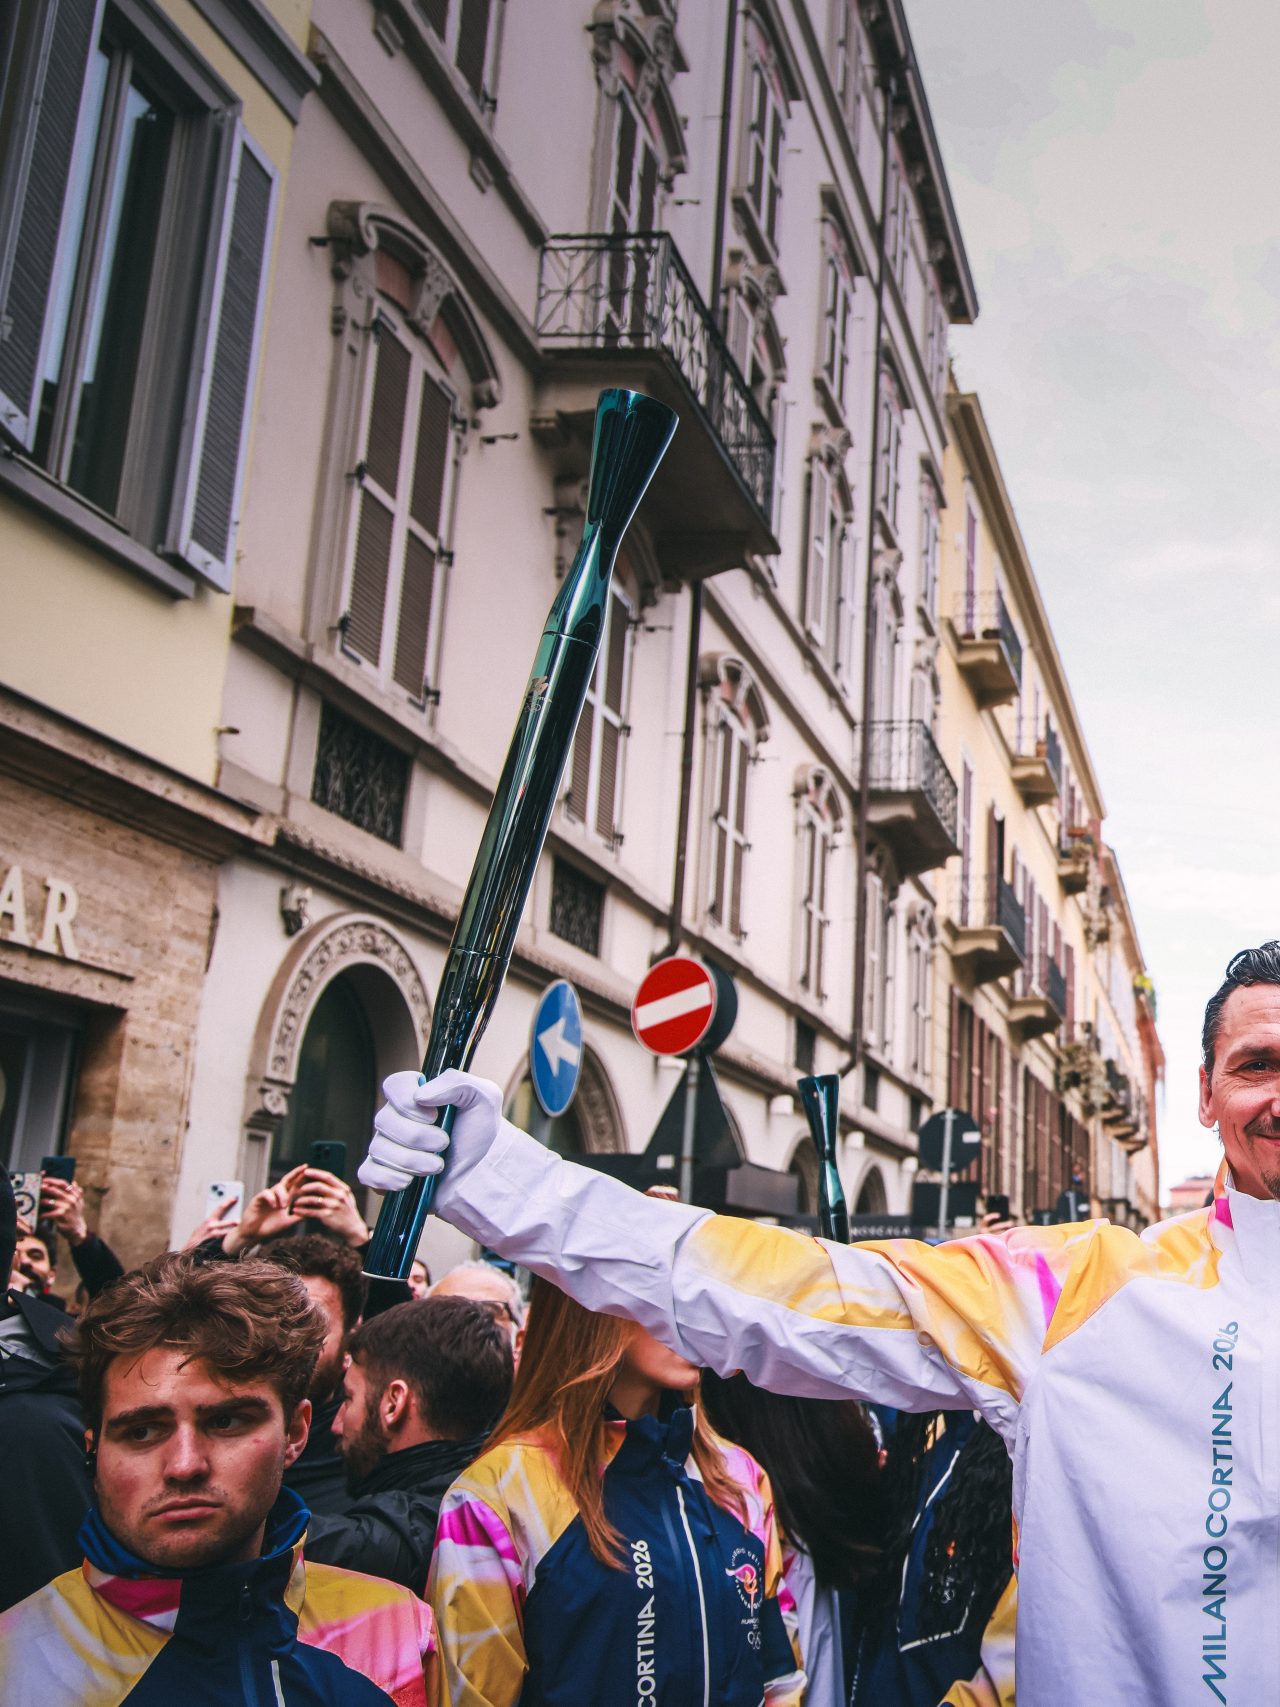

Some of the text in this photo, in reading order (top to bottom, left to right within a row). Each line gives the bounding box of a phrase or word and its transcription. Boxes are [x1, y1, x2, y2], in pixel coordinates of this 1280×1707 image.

[1205, 1381, 1233, 1538] CORTINA
[631, 1540, 655, 1589] 2026
[1202, 1545, 1228, 1707] MILANO
